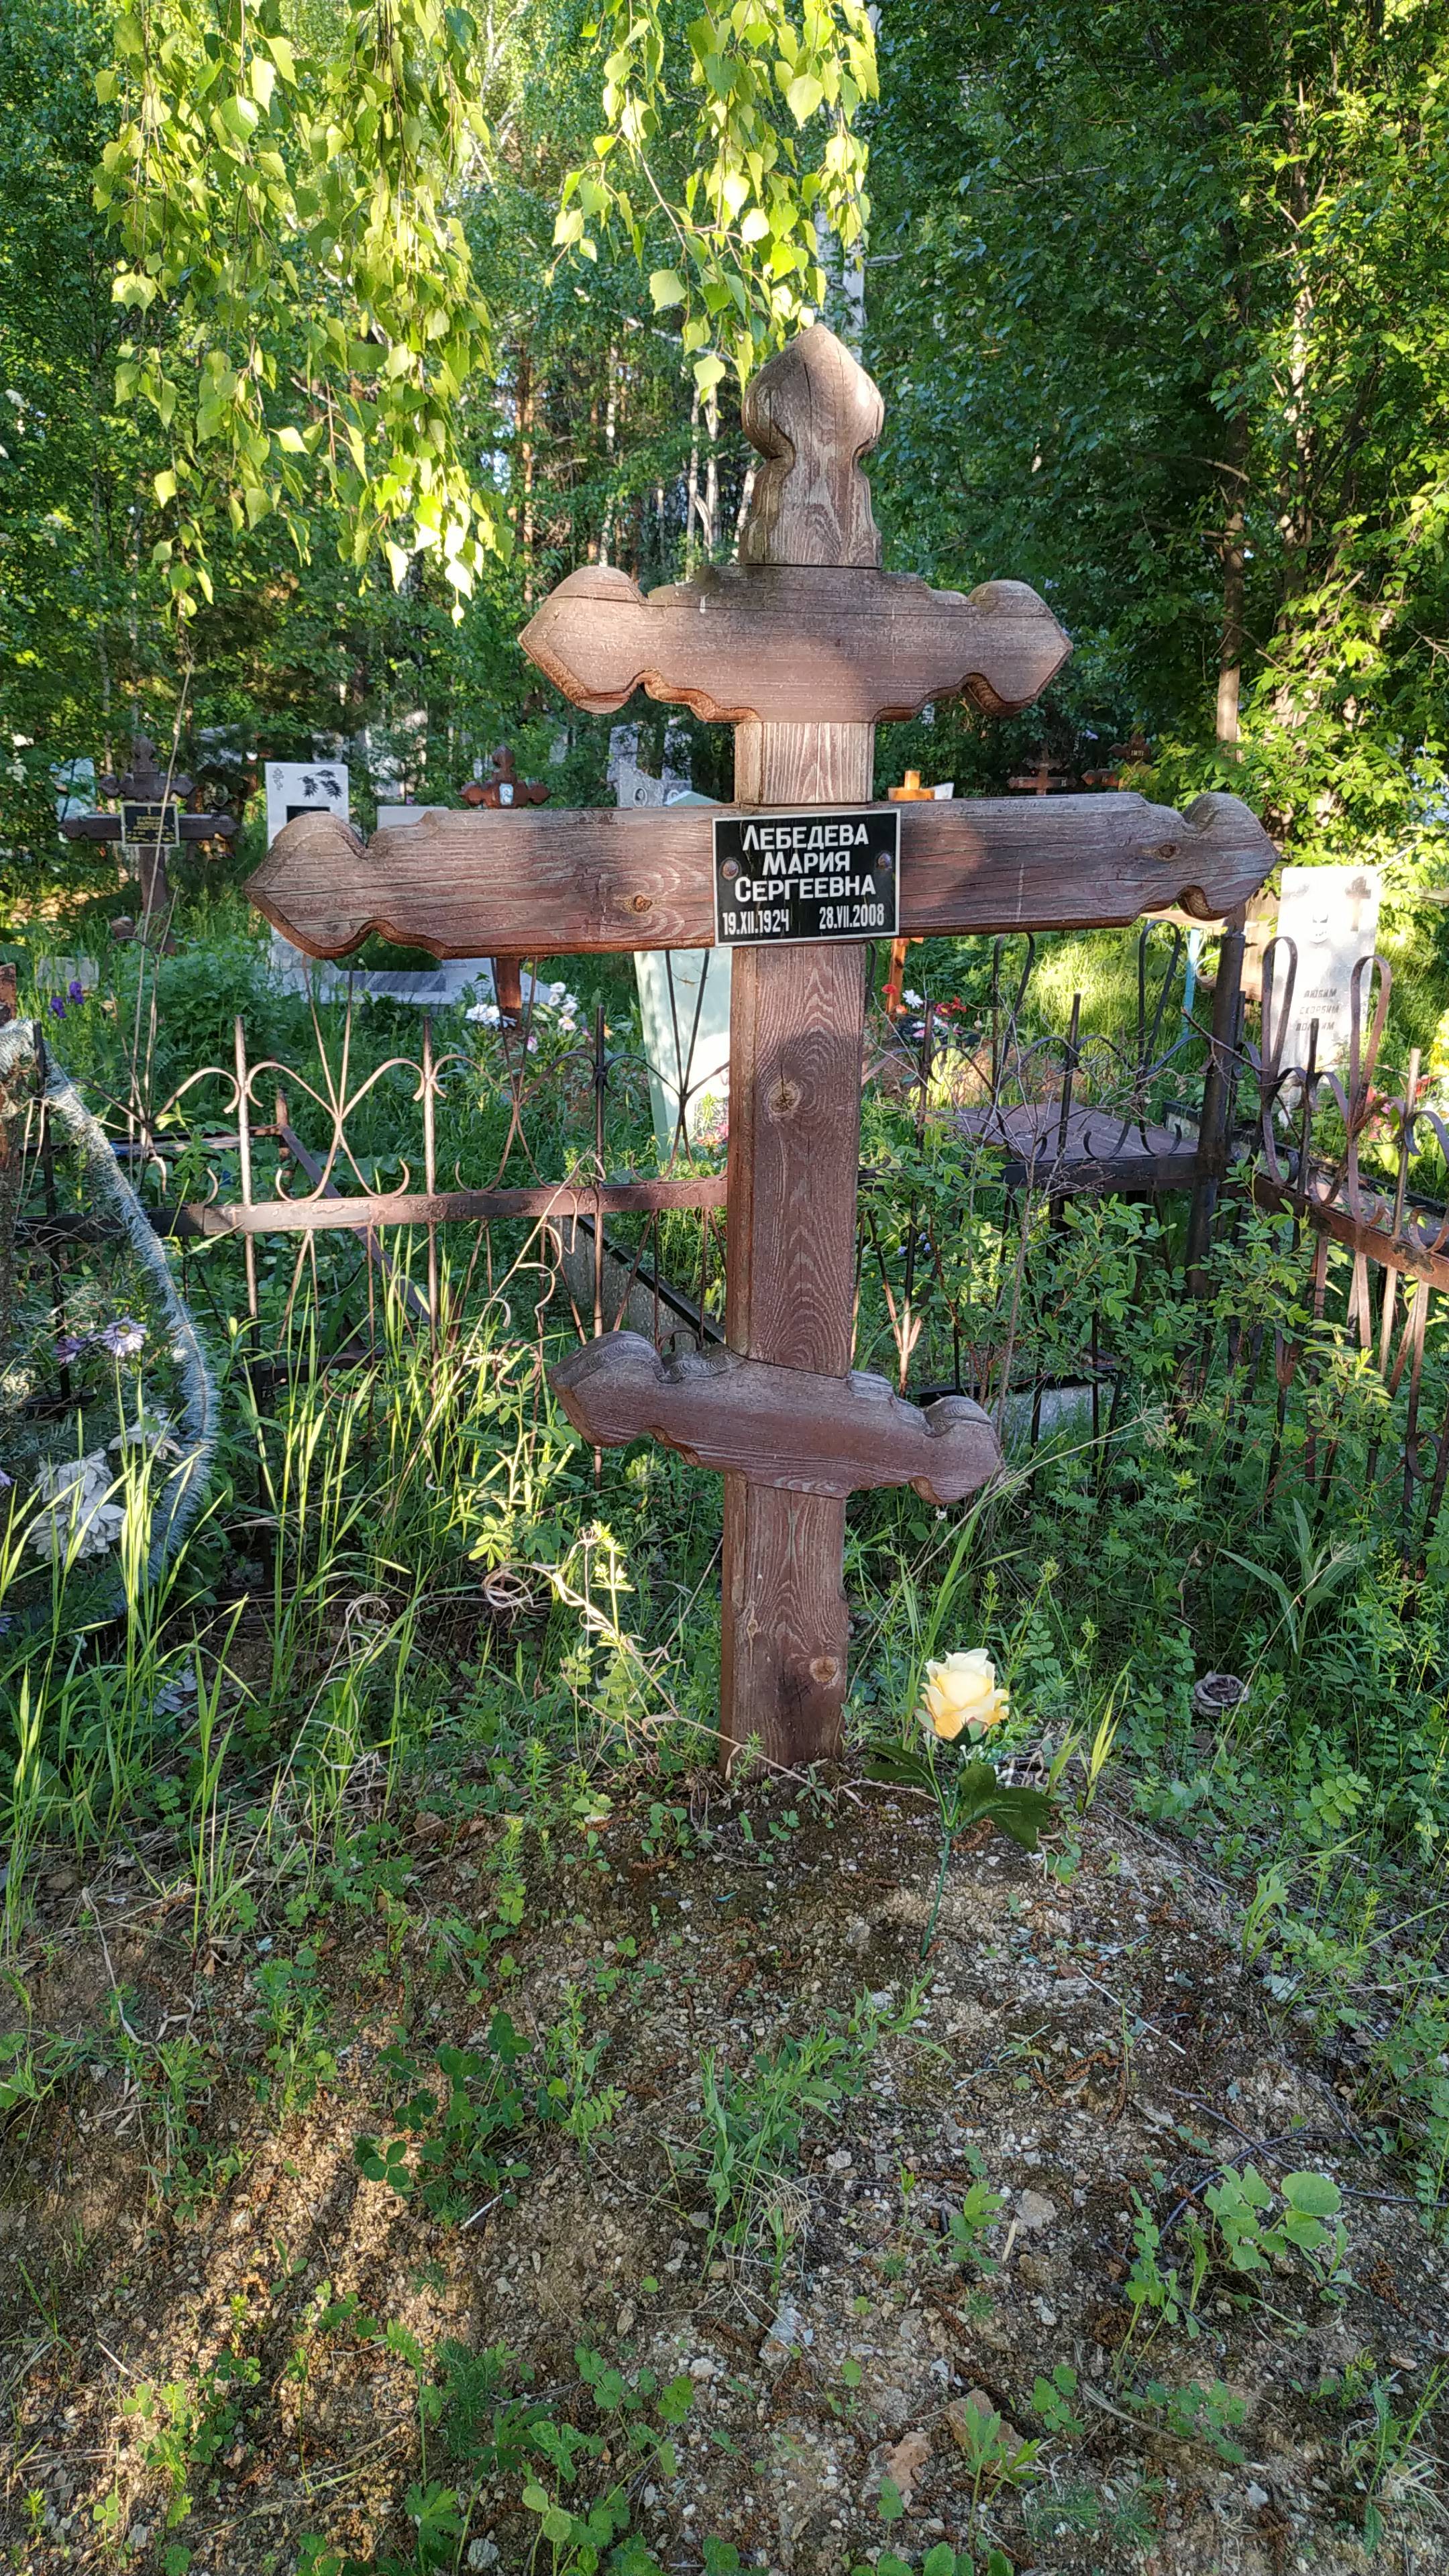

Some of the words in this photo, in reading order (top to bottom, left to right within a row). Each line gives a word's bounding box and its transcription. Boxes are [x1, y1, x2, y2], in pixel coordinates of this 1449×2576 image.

[743, 824, 869, 851] ЛЕБЕДЕВА
[762, 851, 850, 875] МАРИЯ
[735, 875, 875, 902] СЕРГЕЕВНА
[722, 909, 789, 935] 19.XII.1924
[819, 904, 884, 929] 28.VII.2008
[1295, 1022, 1335, 1031] ПОИМ
